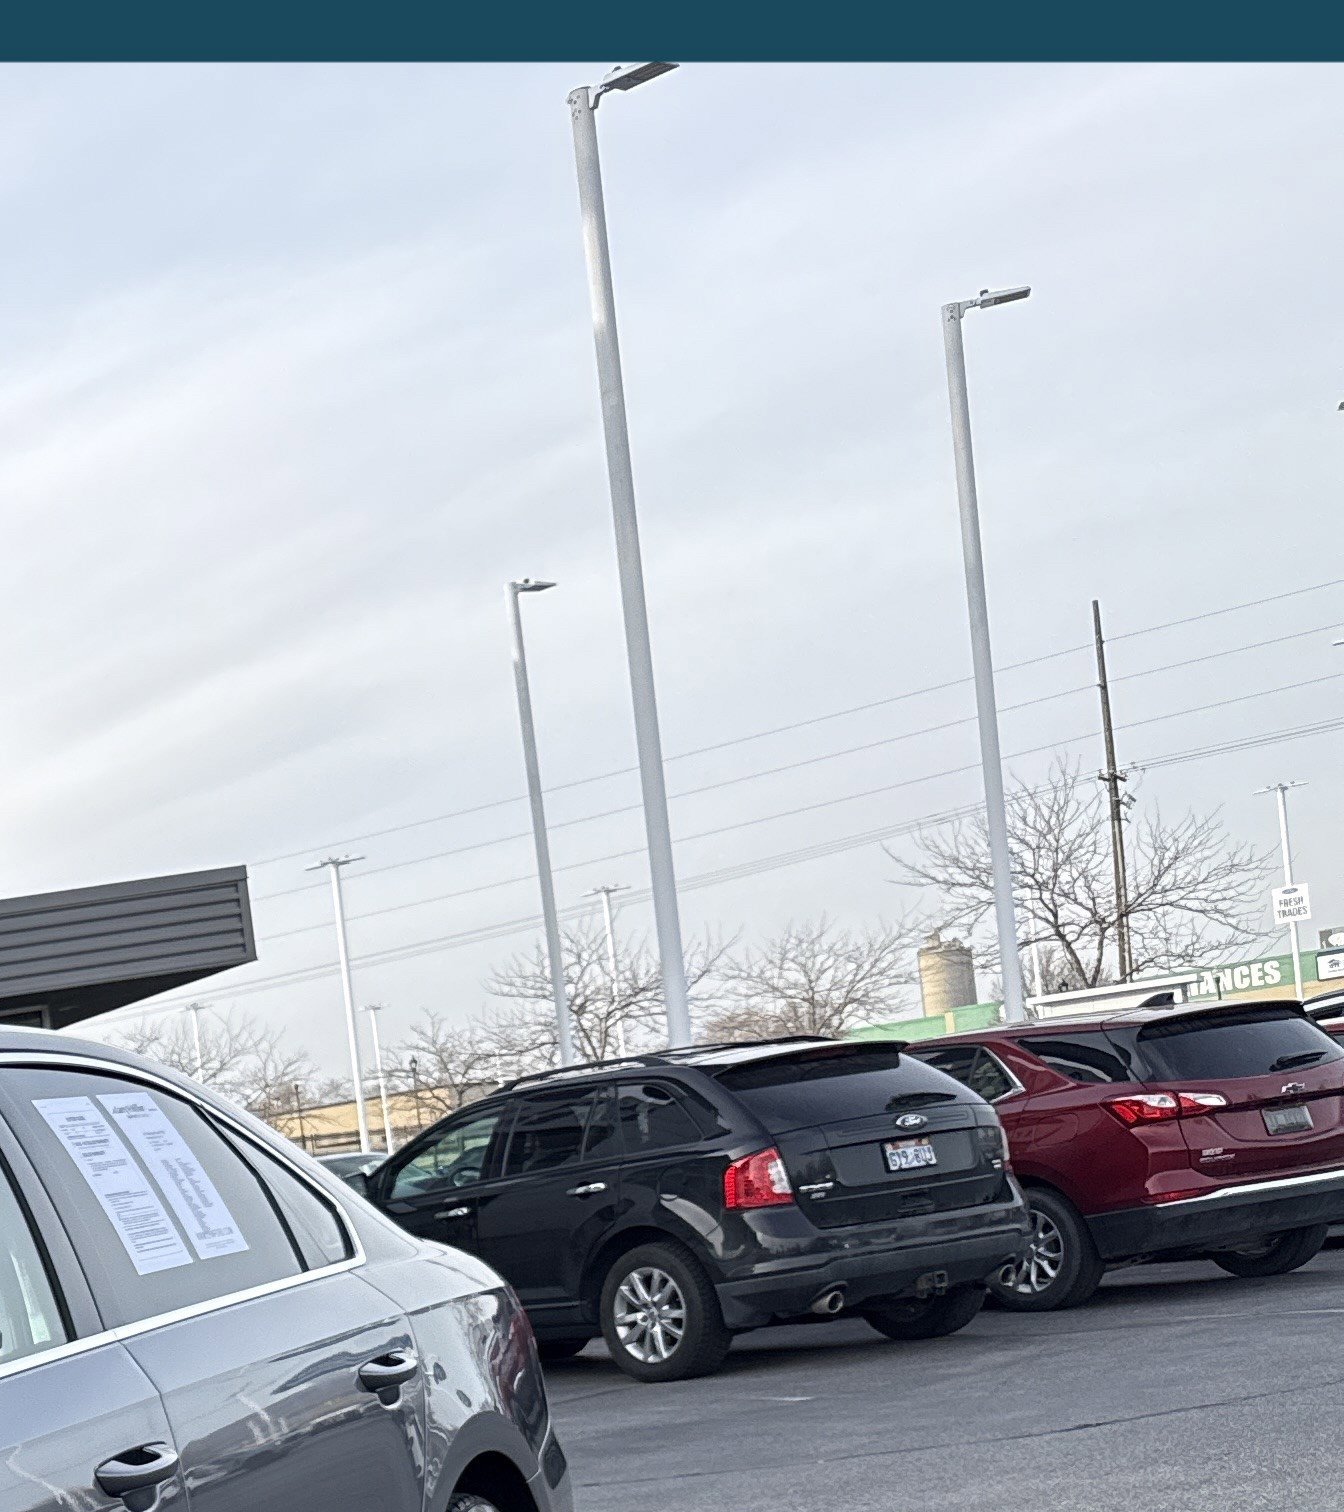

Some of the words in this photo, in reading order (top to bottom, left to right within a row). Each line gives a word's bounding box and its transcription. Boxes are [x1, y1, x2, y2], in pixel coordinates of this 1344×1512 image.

[1278, 895, 1304, 908] FRESH
[1276, 905, 1308, 919] TRADES
[1187, 960, 1282, 998] IANCES
